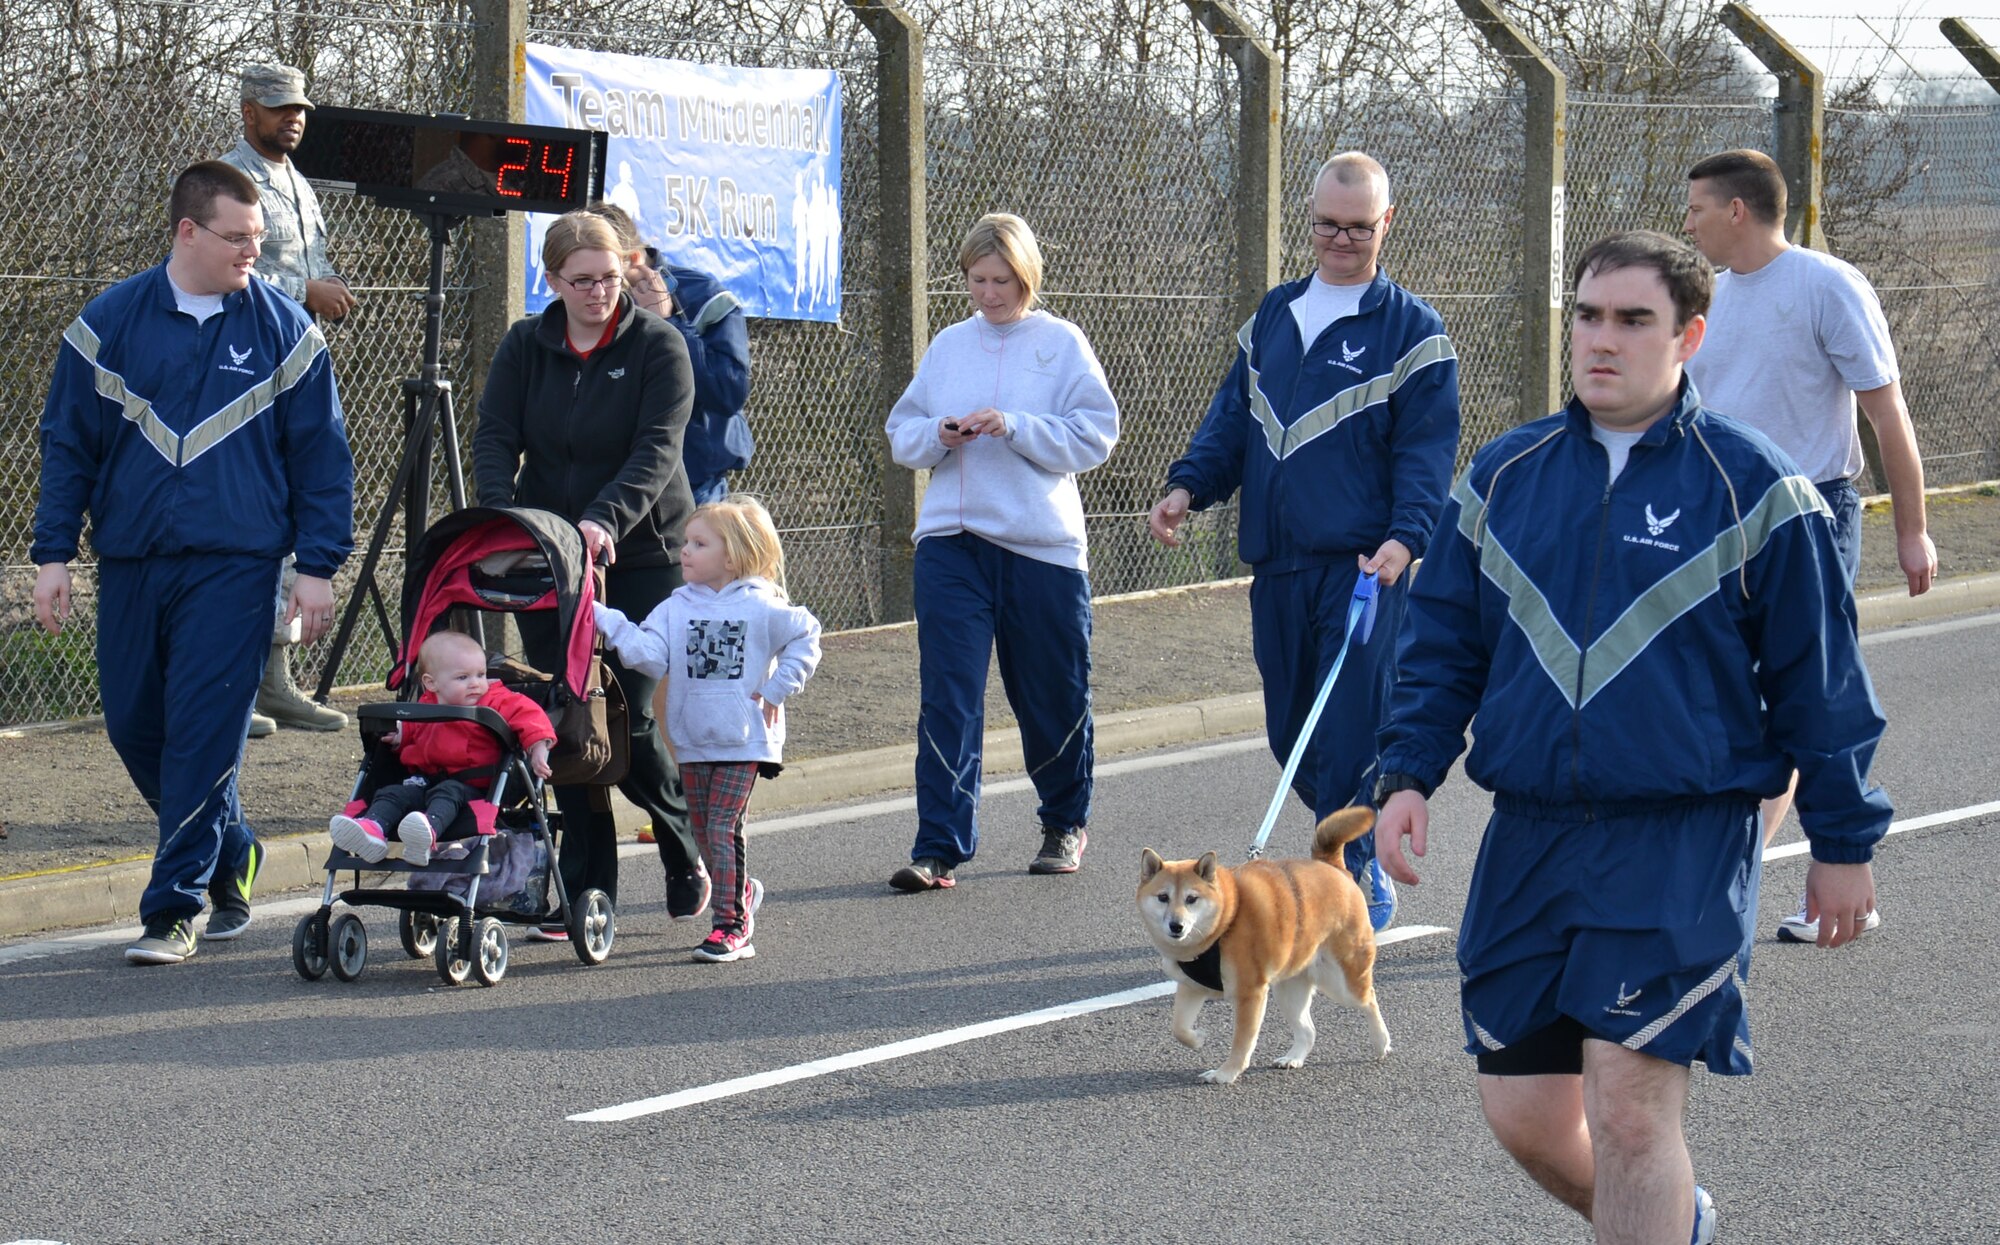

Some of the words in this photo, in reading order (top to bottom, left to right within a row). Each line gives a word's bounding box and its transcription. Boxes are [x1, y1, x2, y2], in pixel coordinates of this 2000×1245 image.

[552, 74, 667, 139] Team
[496, 138, 574, 198] 24
[665, 175, 712, 239] 5K
[719, 177, 778, 242] Run
[1552, 192, 1562, 301] 2190
[1623, 535, 1639, 543] U.S.
[1639, 538, 1654, 546] AIR
[1653, 540, 1680, 552] FORCE
